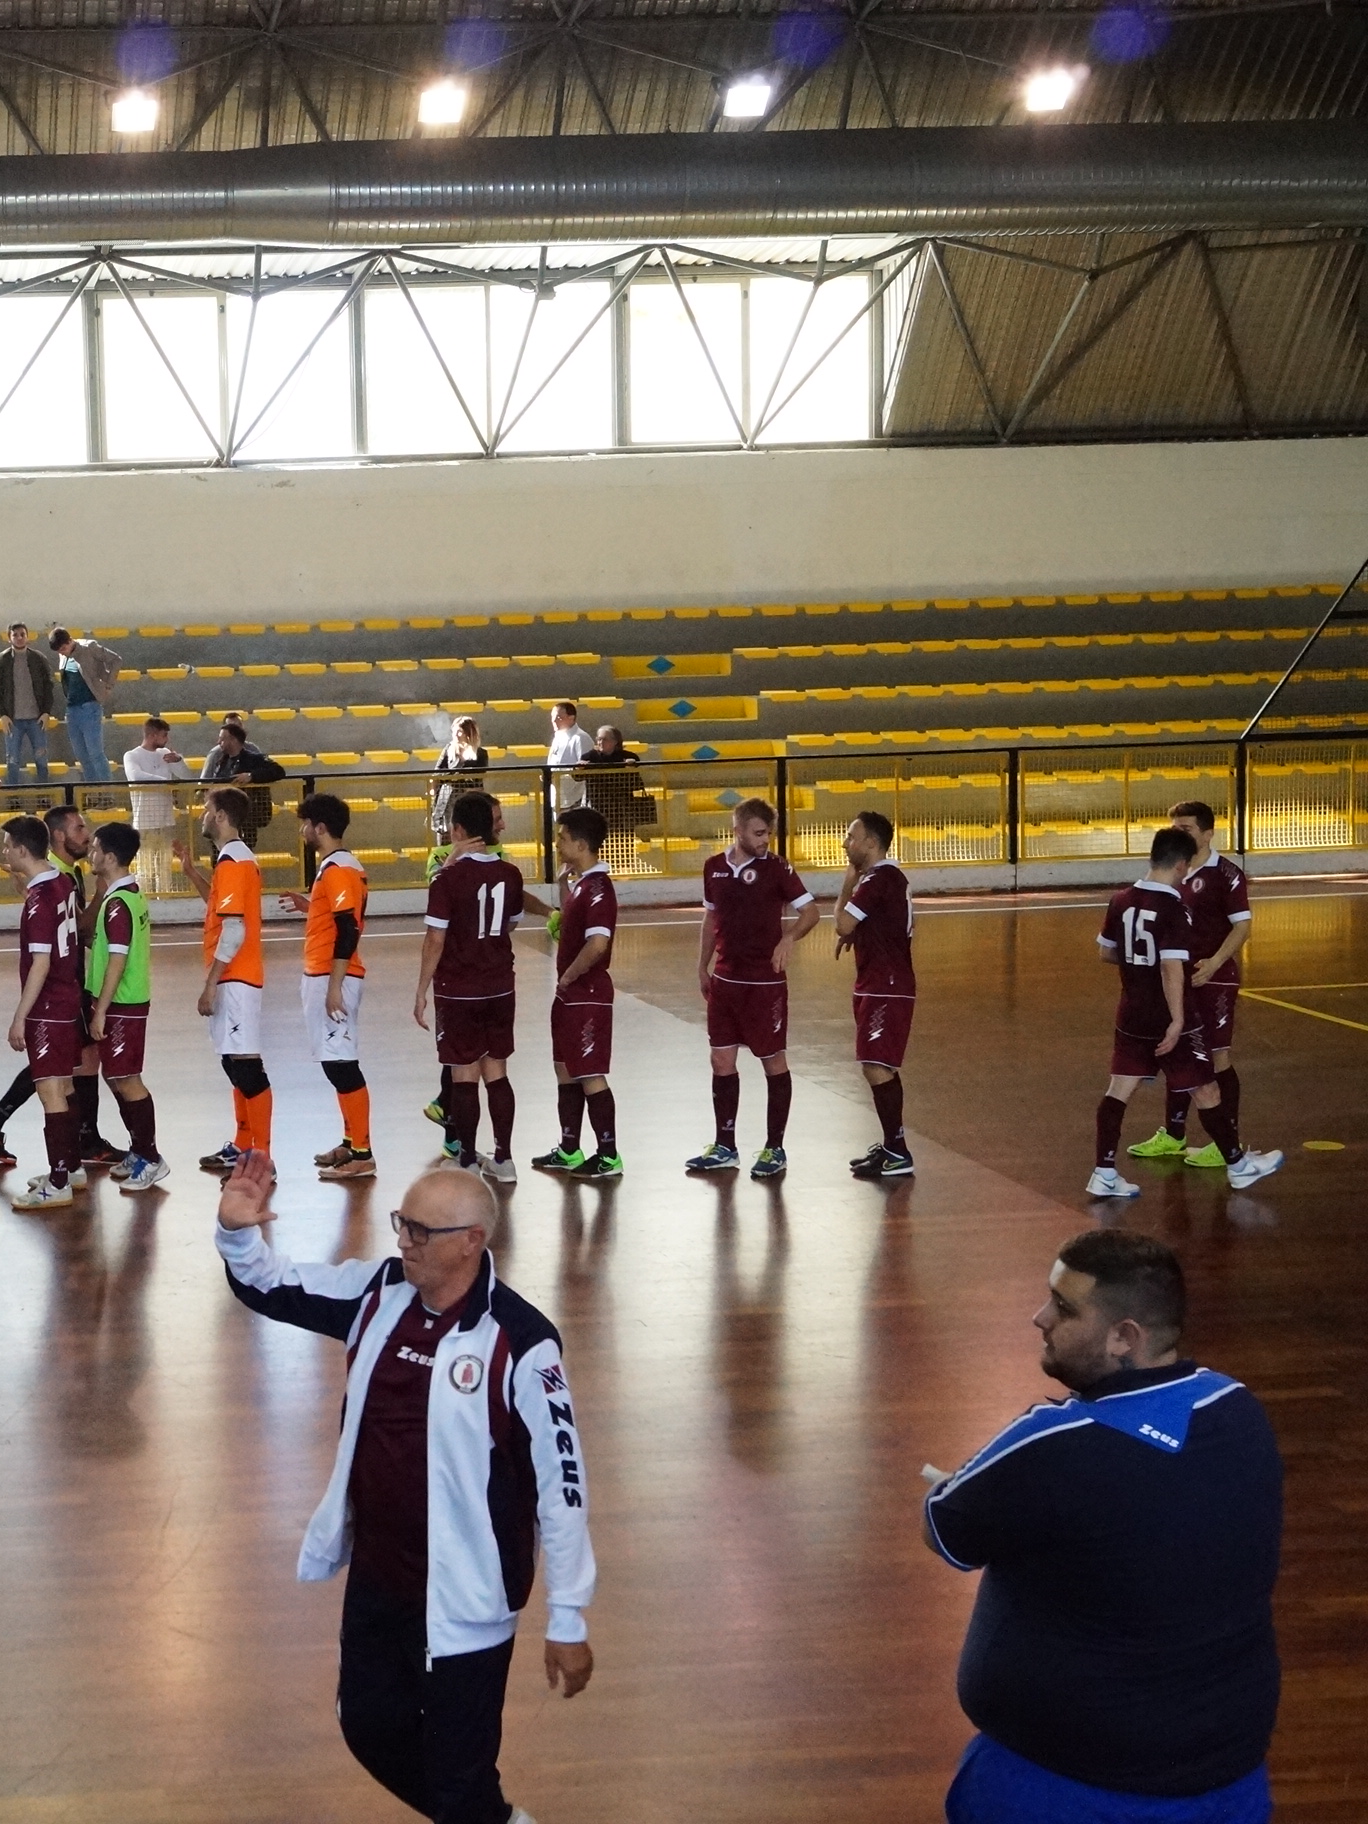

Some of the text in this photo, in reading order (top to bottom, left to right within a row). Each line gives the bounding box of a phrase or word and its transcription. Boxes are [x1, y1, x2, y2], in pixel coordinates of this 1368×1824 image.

[57, 891, 78, 958] 24
[477, 881, 506, 940] 11
[1121, 906, 1158, 967] 15
[396, 1345, 436, 1367] Zeus
[547, 1398, 582, 1508] Zeus
[1138, 1423, 1180, 1448] Zeus
